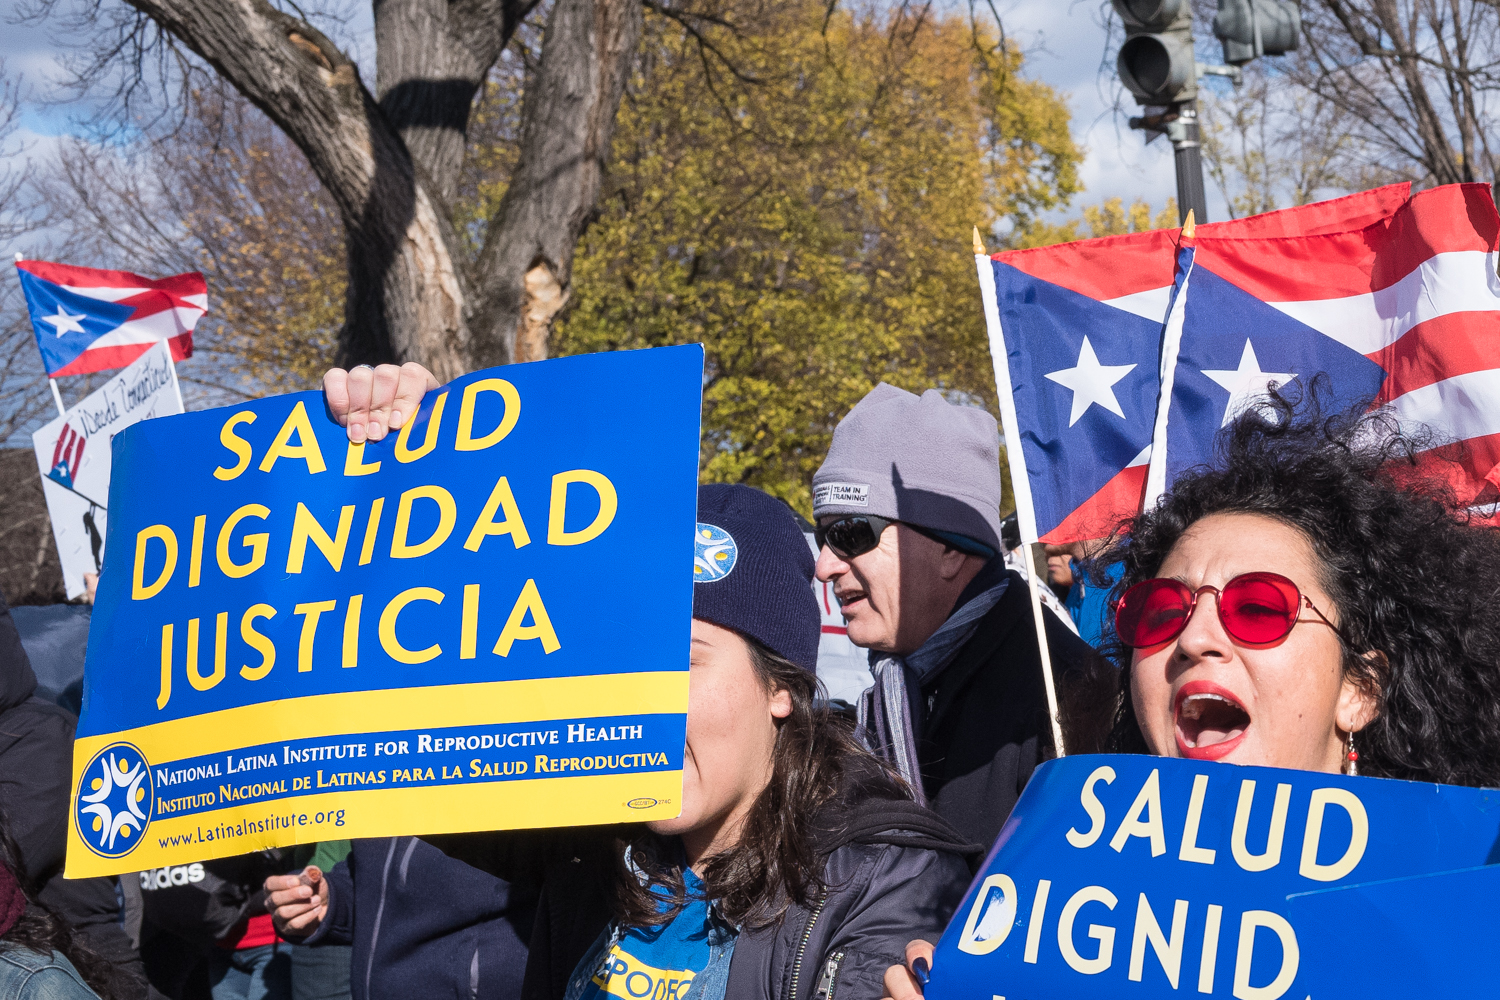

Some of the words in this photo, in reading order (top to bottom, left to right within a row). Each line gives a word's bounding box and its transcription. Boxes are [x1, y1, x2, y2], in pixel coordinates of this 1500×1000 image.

[213, 378, 521, 481] SALUD
[131, 469, 618, 600] DIGNIDAD
[156, 579, 561, 711] JUSTICIA
[157, 763, 222, 788] NATIONAL
[226, 753, 278, 775] LATINA
[283, 743, 367, 765] INSTITUTE
[417, 730, 559, 753] REPRODUCTIVE
[567, 723, 643, 744] HEALTH
[157, 791, 216, 815] INSTITUTO
[219, 780, 288, 804] NACIONAL
[316, 769, 387, 789] LATINAS
[469, 758, 528, 778] SALUD
[534, 751, 669, 773] REPRODUCTIVA
[158, 809, 346, 849] www.LatinaInstitute.org
[1065, 766, 1369, 882] SALUD
